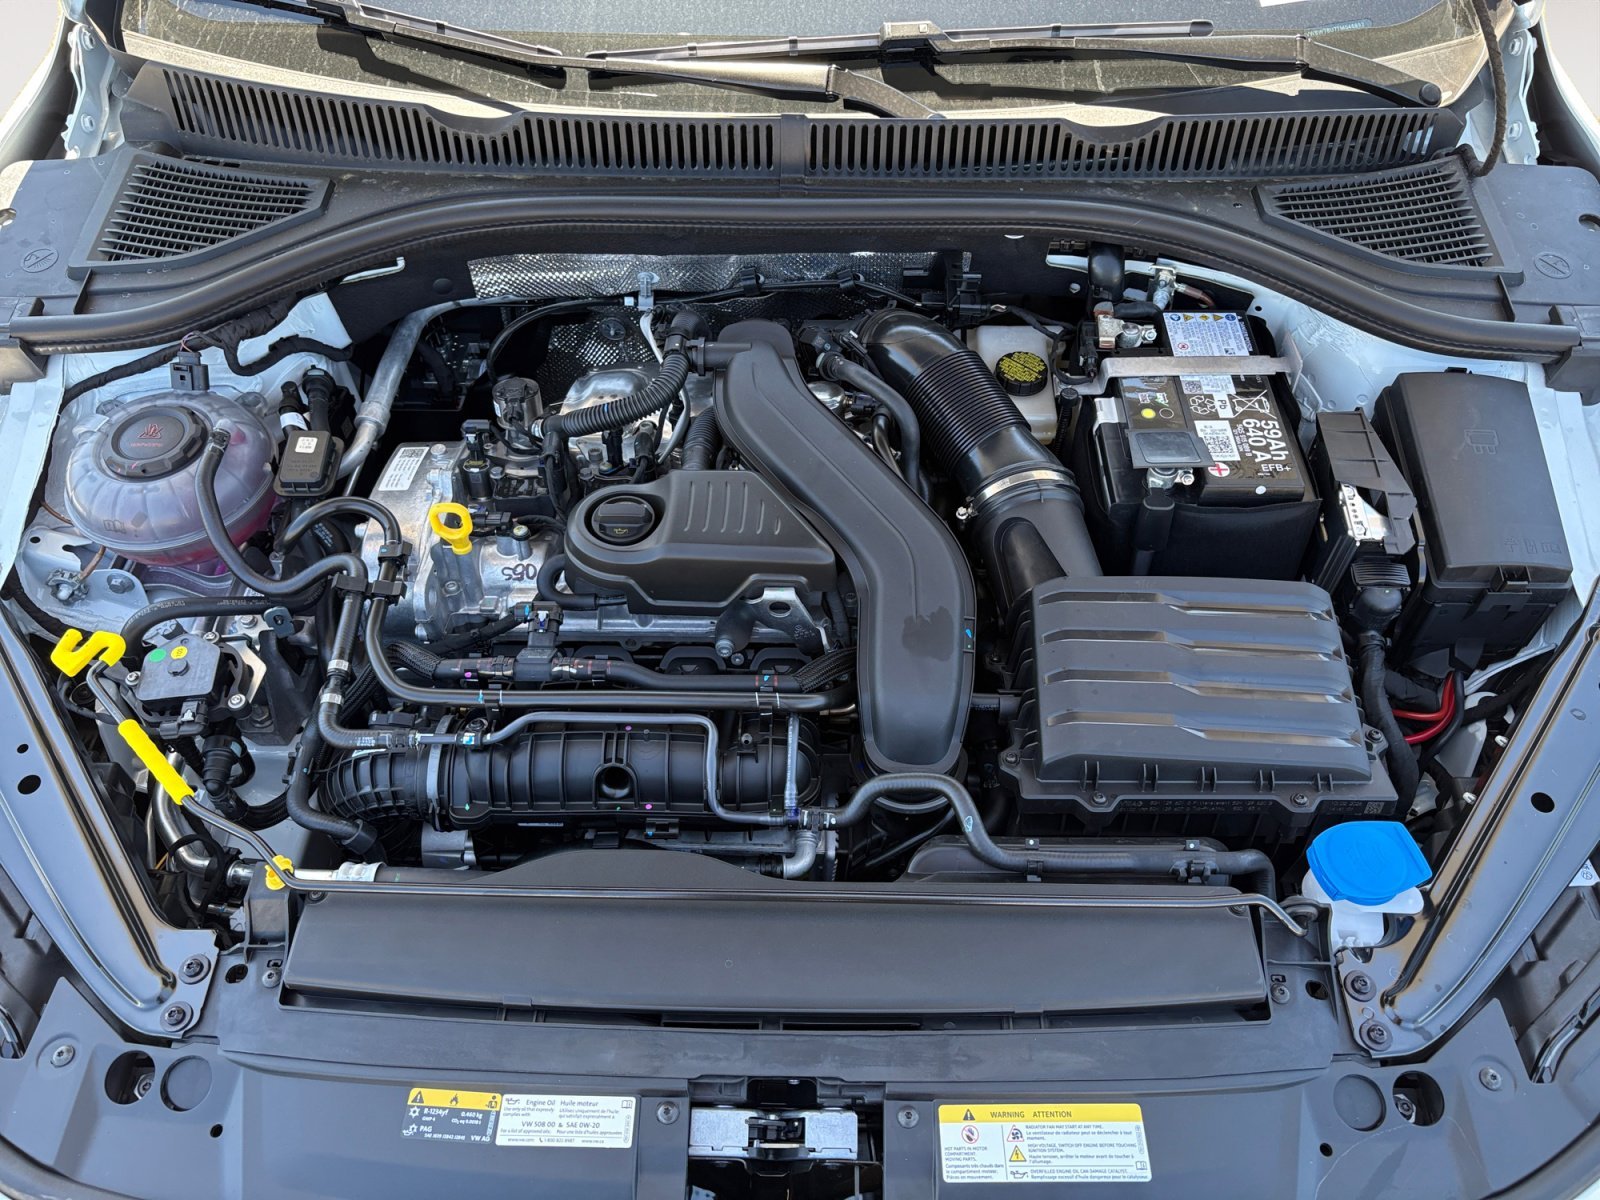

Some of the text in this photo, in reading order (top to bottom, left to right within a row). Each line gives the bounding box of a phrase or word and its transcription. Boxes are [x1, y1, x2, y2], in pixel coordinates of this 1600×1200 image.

[1218, 400, 1228, 410] Pb
[1243, 419, 1267, 446] 640
[1261, 420, 1289, 460] 59Ah
[1252, 450, 1272, 462] A
[1261, 464, 1292, 472] EFB+
[424, 1108, 449, 1117] R-1234yf
